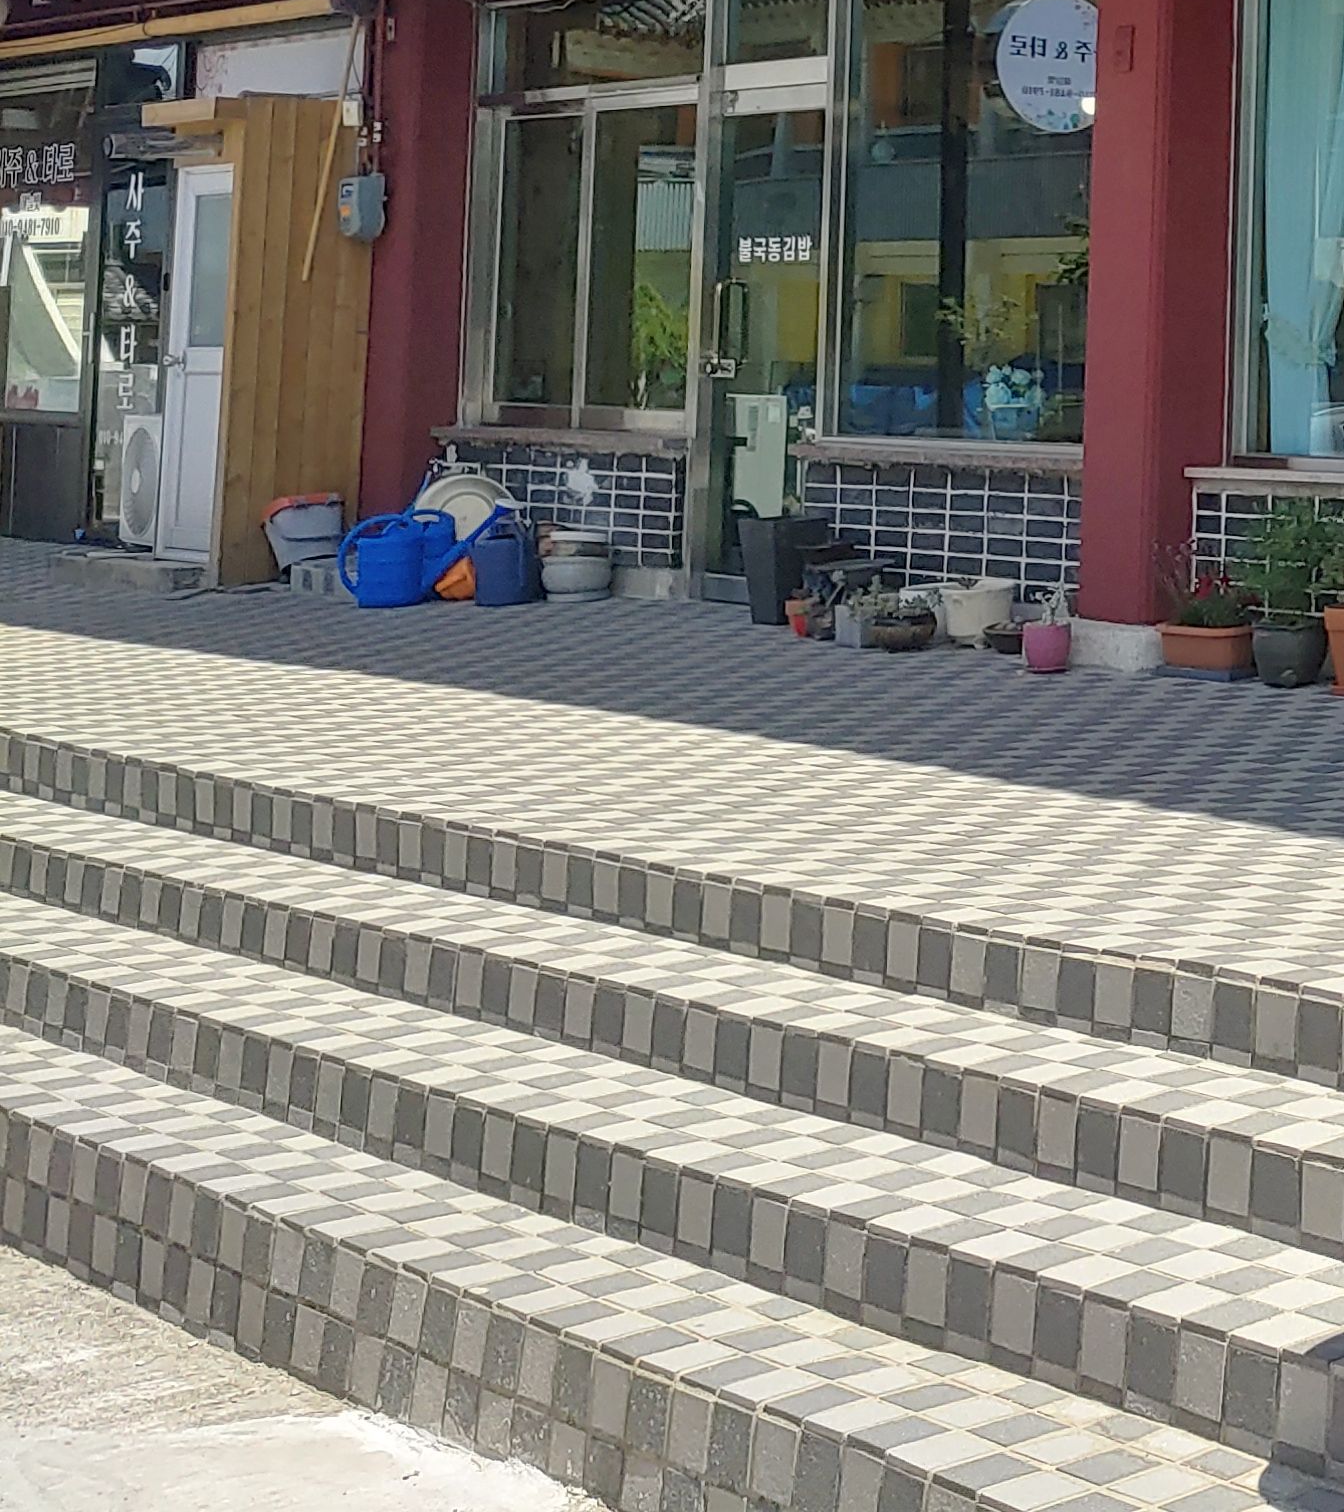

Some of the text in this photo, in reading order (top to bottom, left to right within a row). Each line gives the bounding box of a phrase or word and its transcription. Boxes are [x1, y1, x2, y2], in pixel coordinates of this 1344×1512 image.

[124, 171, 144, 260] 사주
[738, 234, 813, 263] 불국동김밥
[116, 324, 138, 410] 타로
